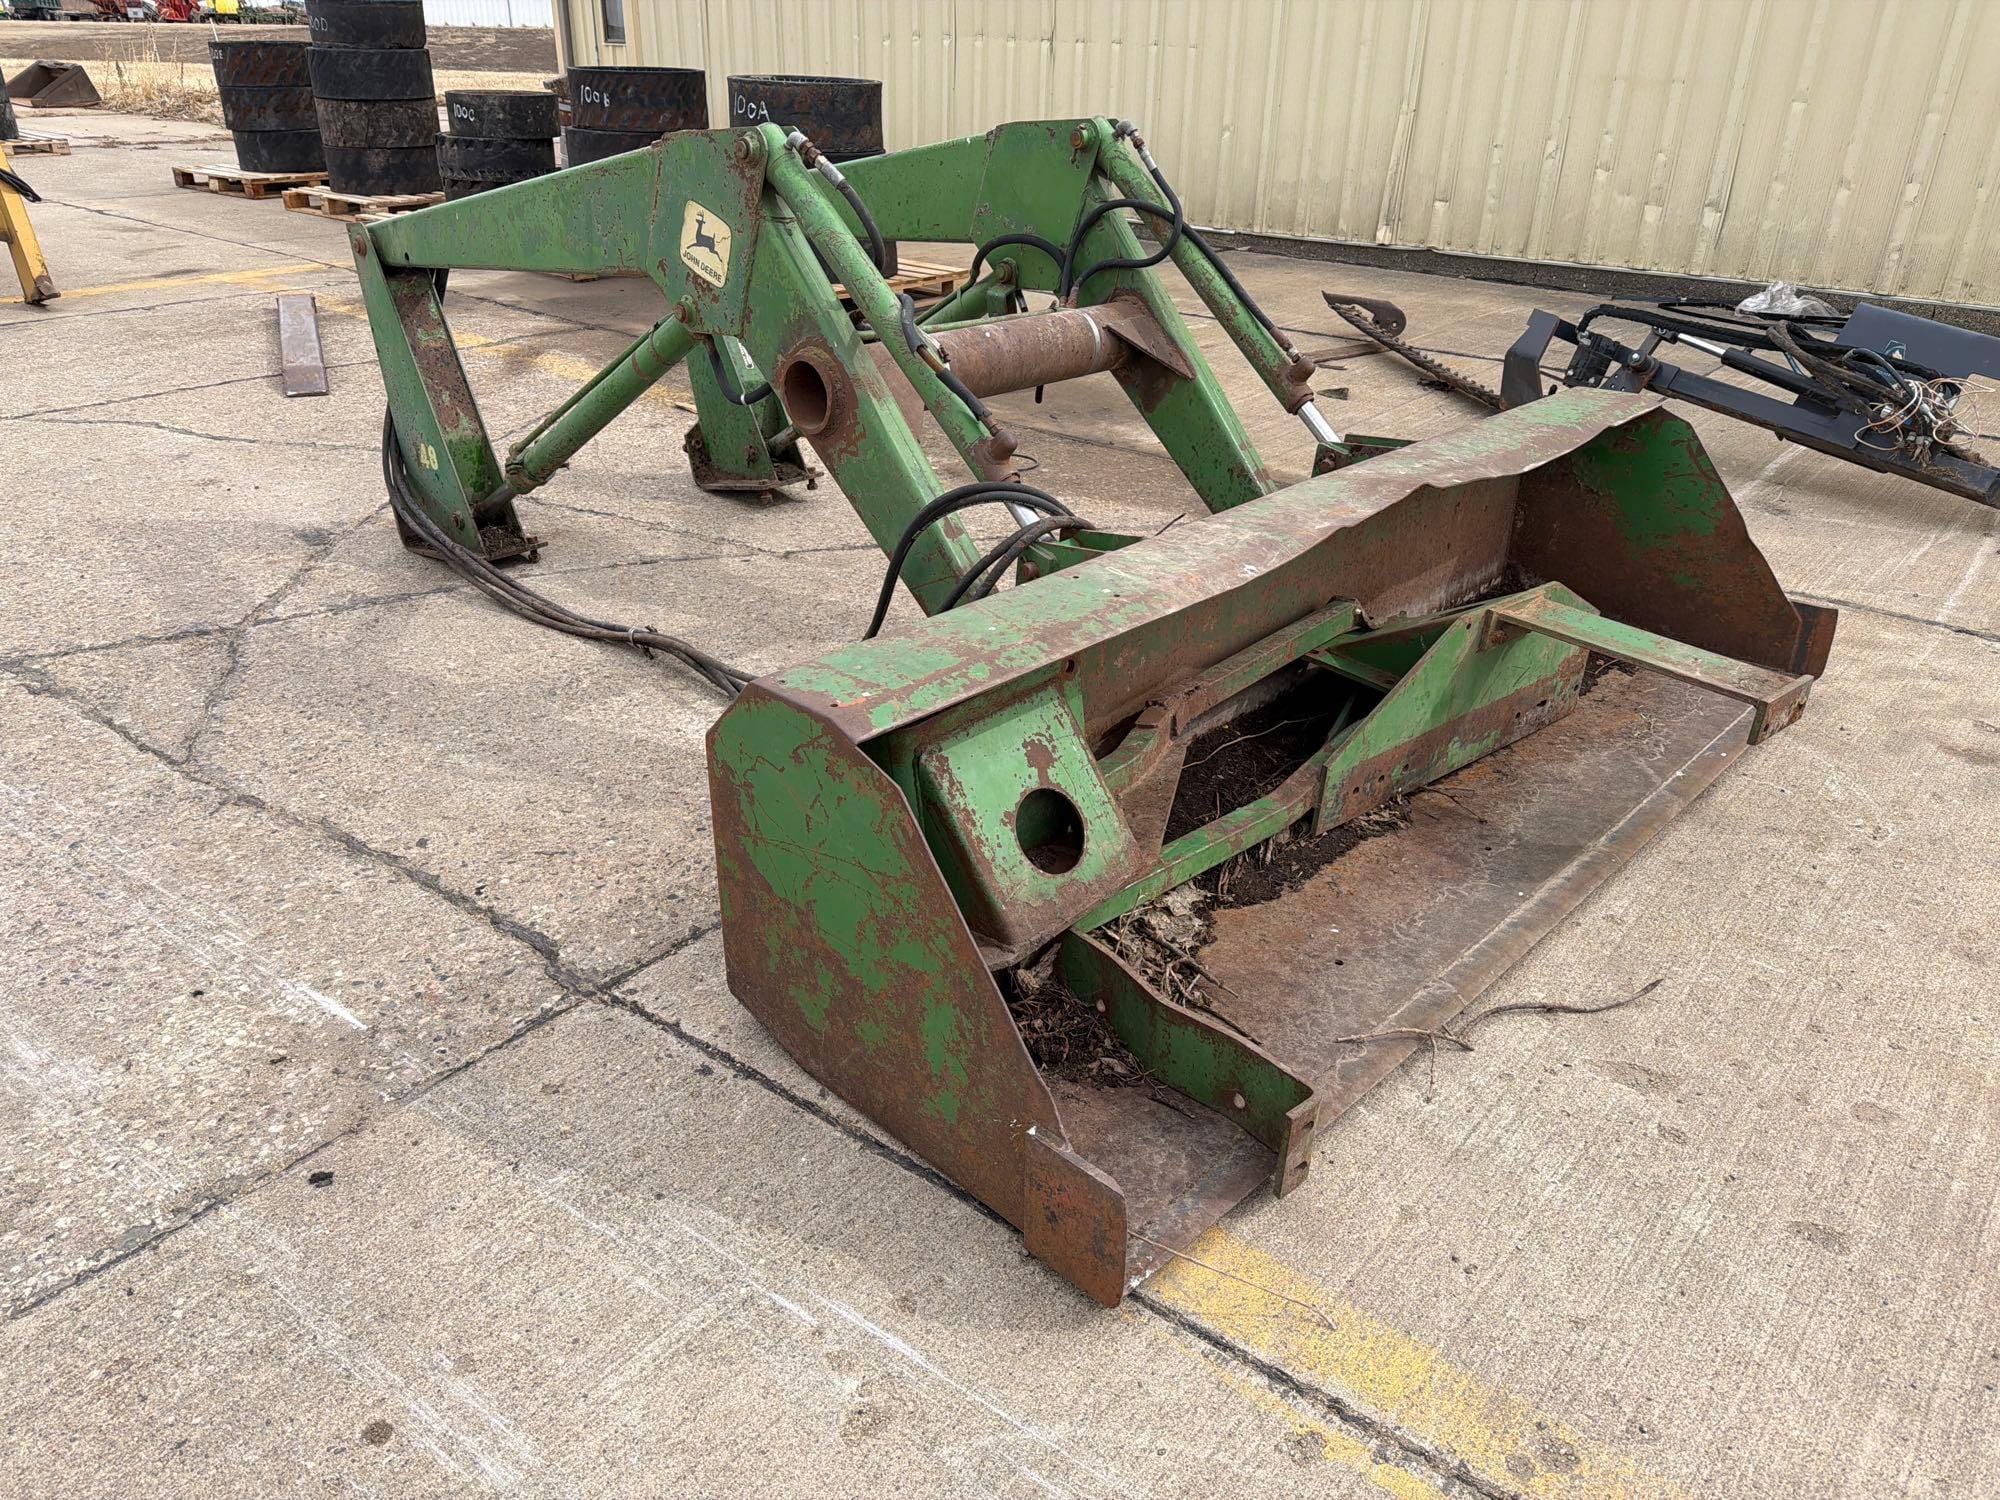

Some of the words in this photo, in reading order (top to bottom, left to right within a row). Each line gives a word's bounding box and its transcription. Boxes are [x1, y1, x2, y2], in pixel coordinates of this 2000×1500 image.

[453, 102, 475, 122] 100C
[733, 91, 770, 122] 100A
[683, 250, 700, 268] JOHN
[700, 262, 722, 284] DEERE
